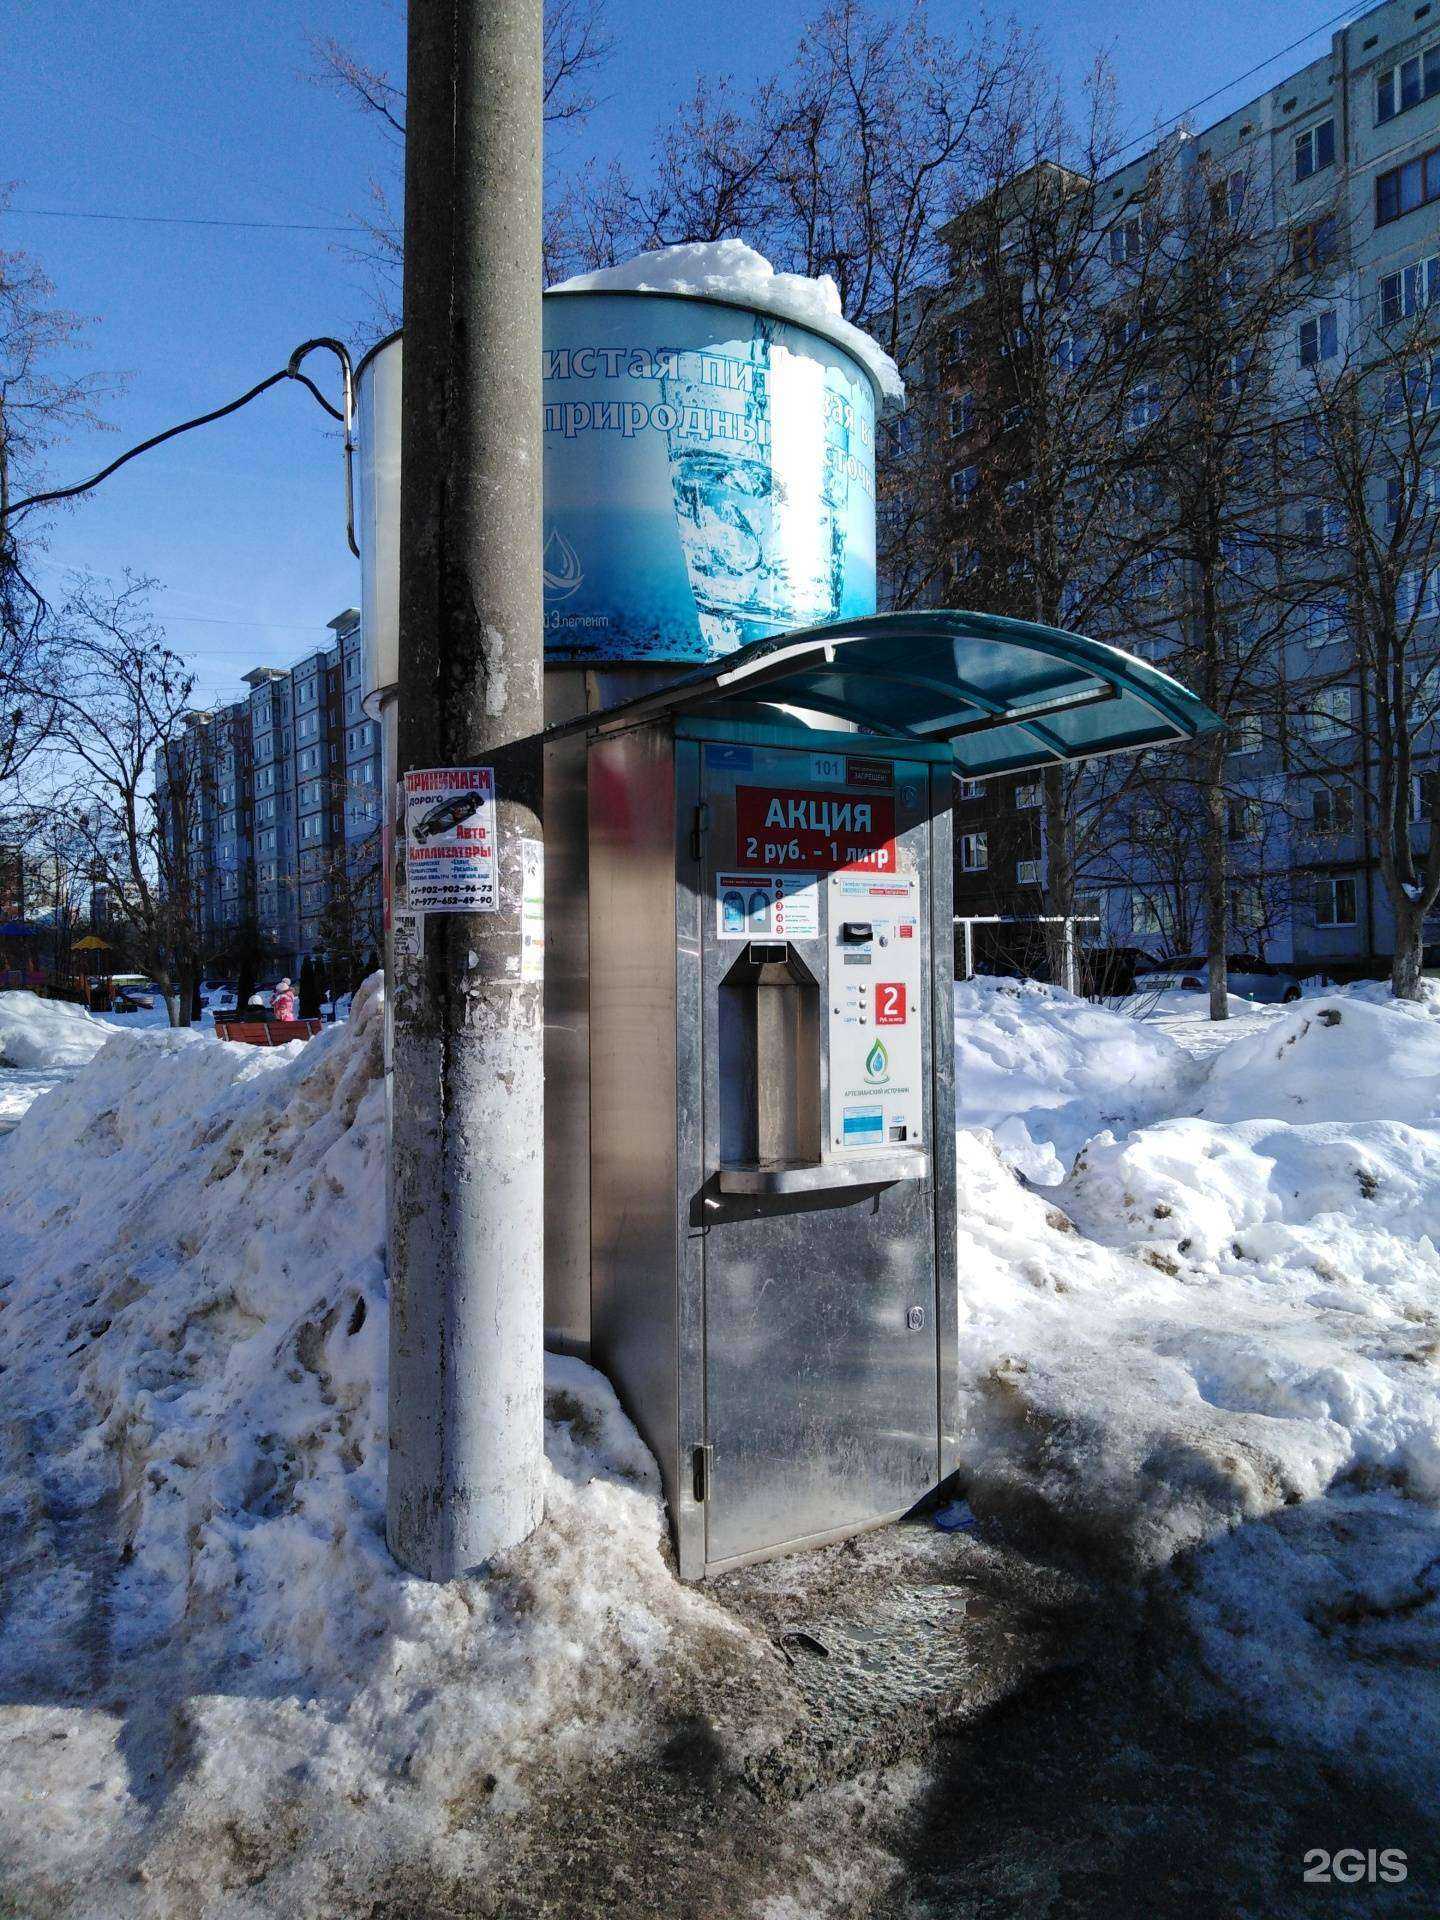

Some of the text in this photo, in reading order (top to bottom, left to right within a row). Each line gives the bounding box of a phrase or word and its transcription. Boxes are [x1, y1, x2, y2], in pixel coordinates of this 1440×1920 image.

[542, 347, 681, 381] истая
[542, 401, 772, 446] природны
[406, 771, 491, 791] ПРИНИМАЕМ
[816, 760, 840, 775] 101
[765, 798, 872, 837] АКЦИЯ
[746, 837, 758, 859] 2
[764, 838, 806, 865] руб.
[830, 842, 838, 862] 1
[845, 846, 889, 869] литр
[883, 986, 898, 1015] 2
